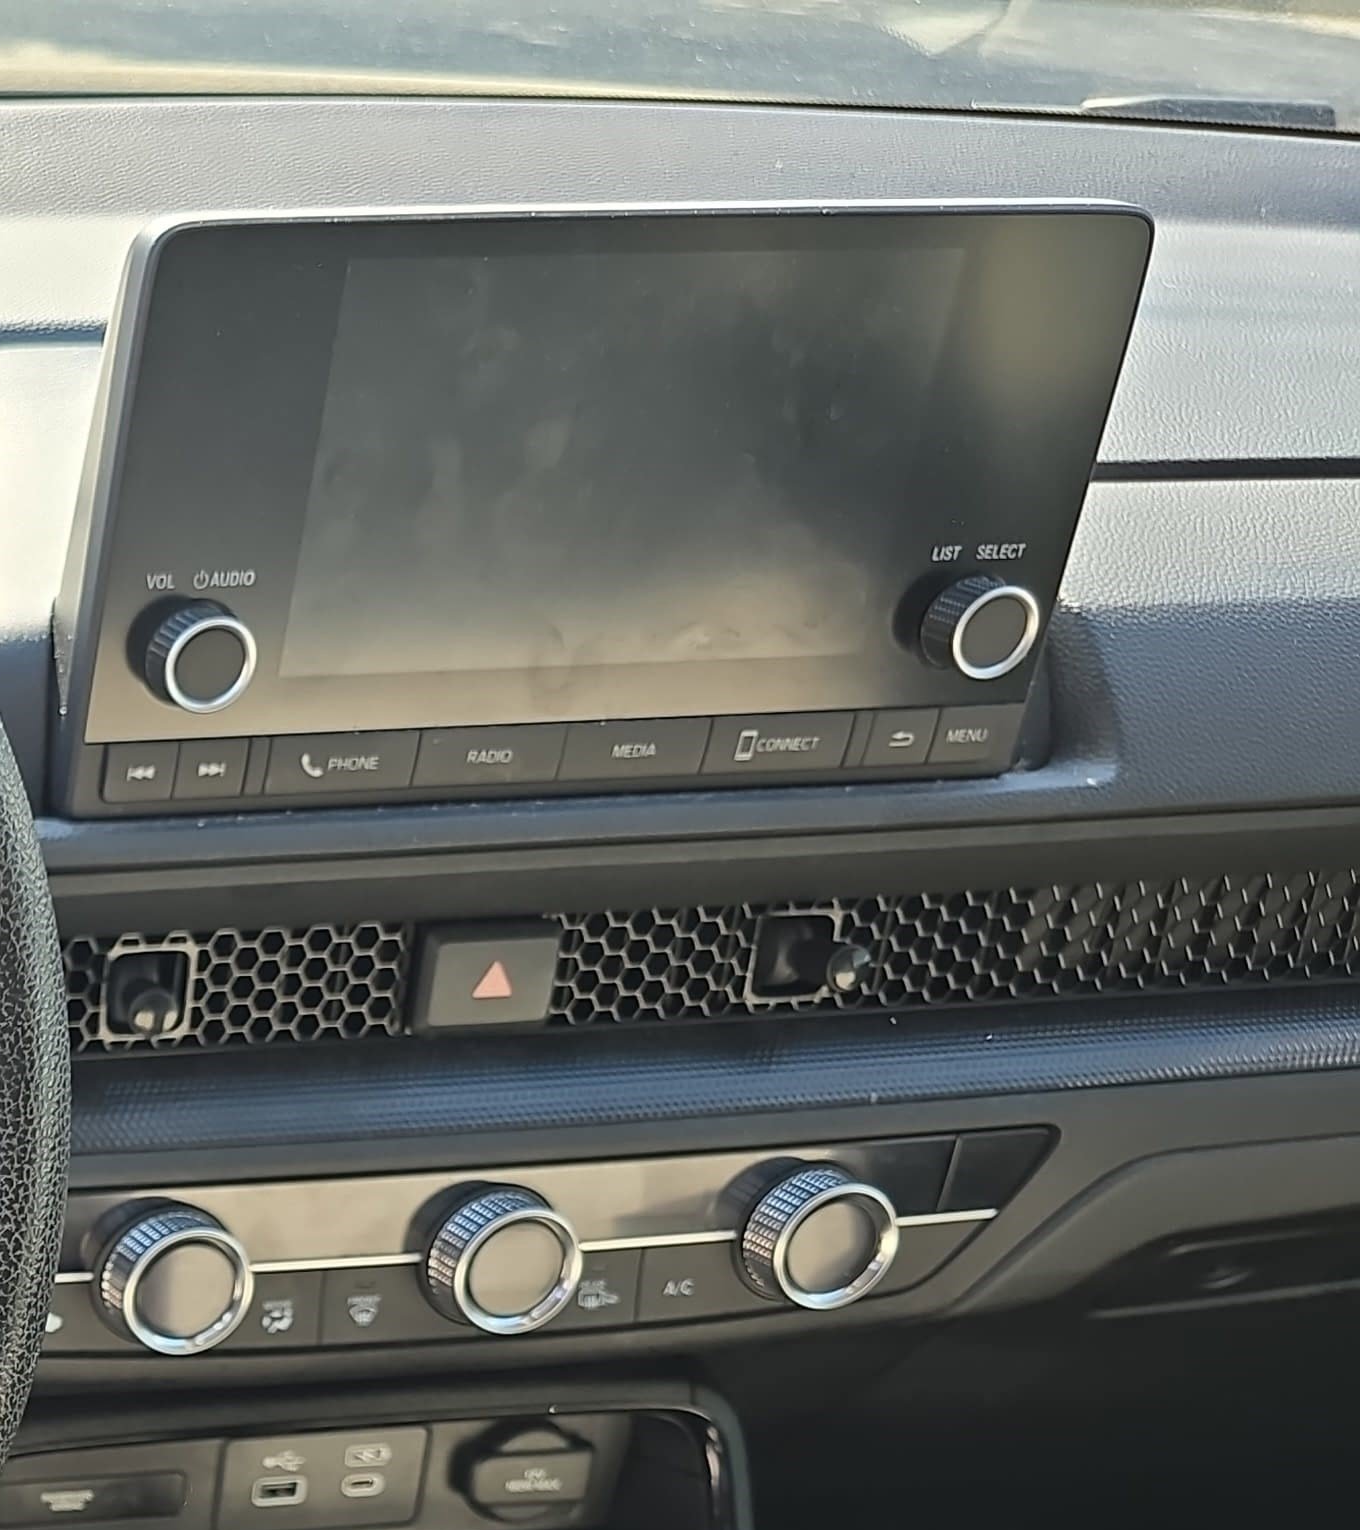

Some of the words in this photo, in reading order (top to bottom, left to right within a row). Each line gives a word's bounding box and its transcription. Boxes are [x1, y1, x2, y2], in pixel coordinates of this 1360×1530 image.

[931, 545, 963, 562] LIST
[975, 543, 1027, 560] SELECT
[146, 573, 176, 590] VOL
[209, 569, 257, 587] AUDIO
[945, 727, 989, 744] MENU
[611, 743, 658, 759] MEDIA
[756, 736, 821, 753] CONNECT
[327, 755, 380, 771] PHONE
[466, 748, 513, 765] RADIO
[663, 1278, 695, 1296] A/C
